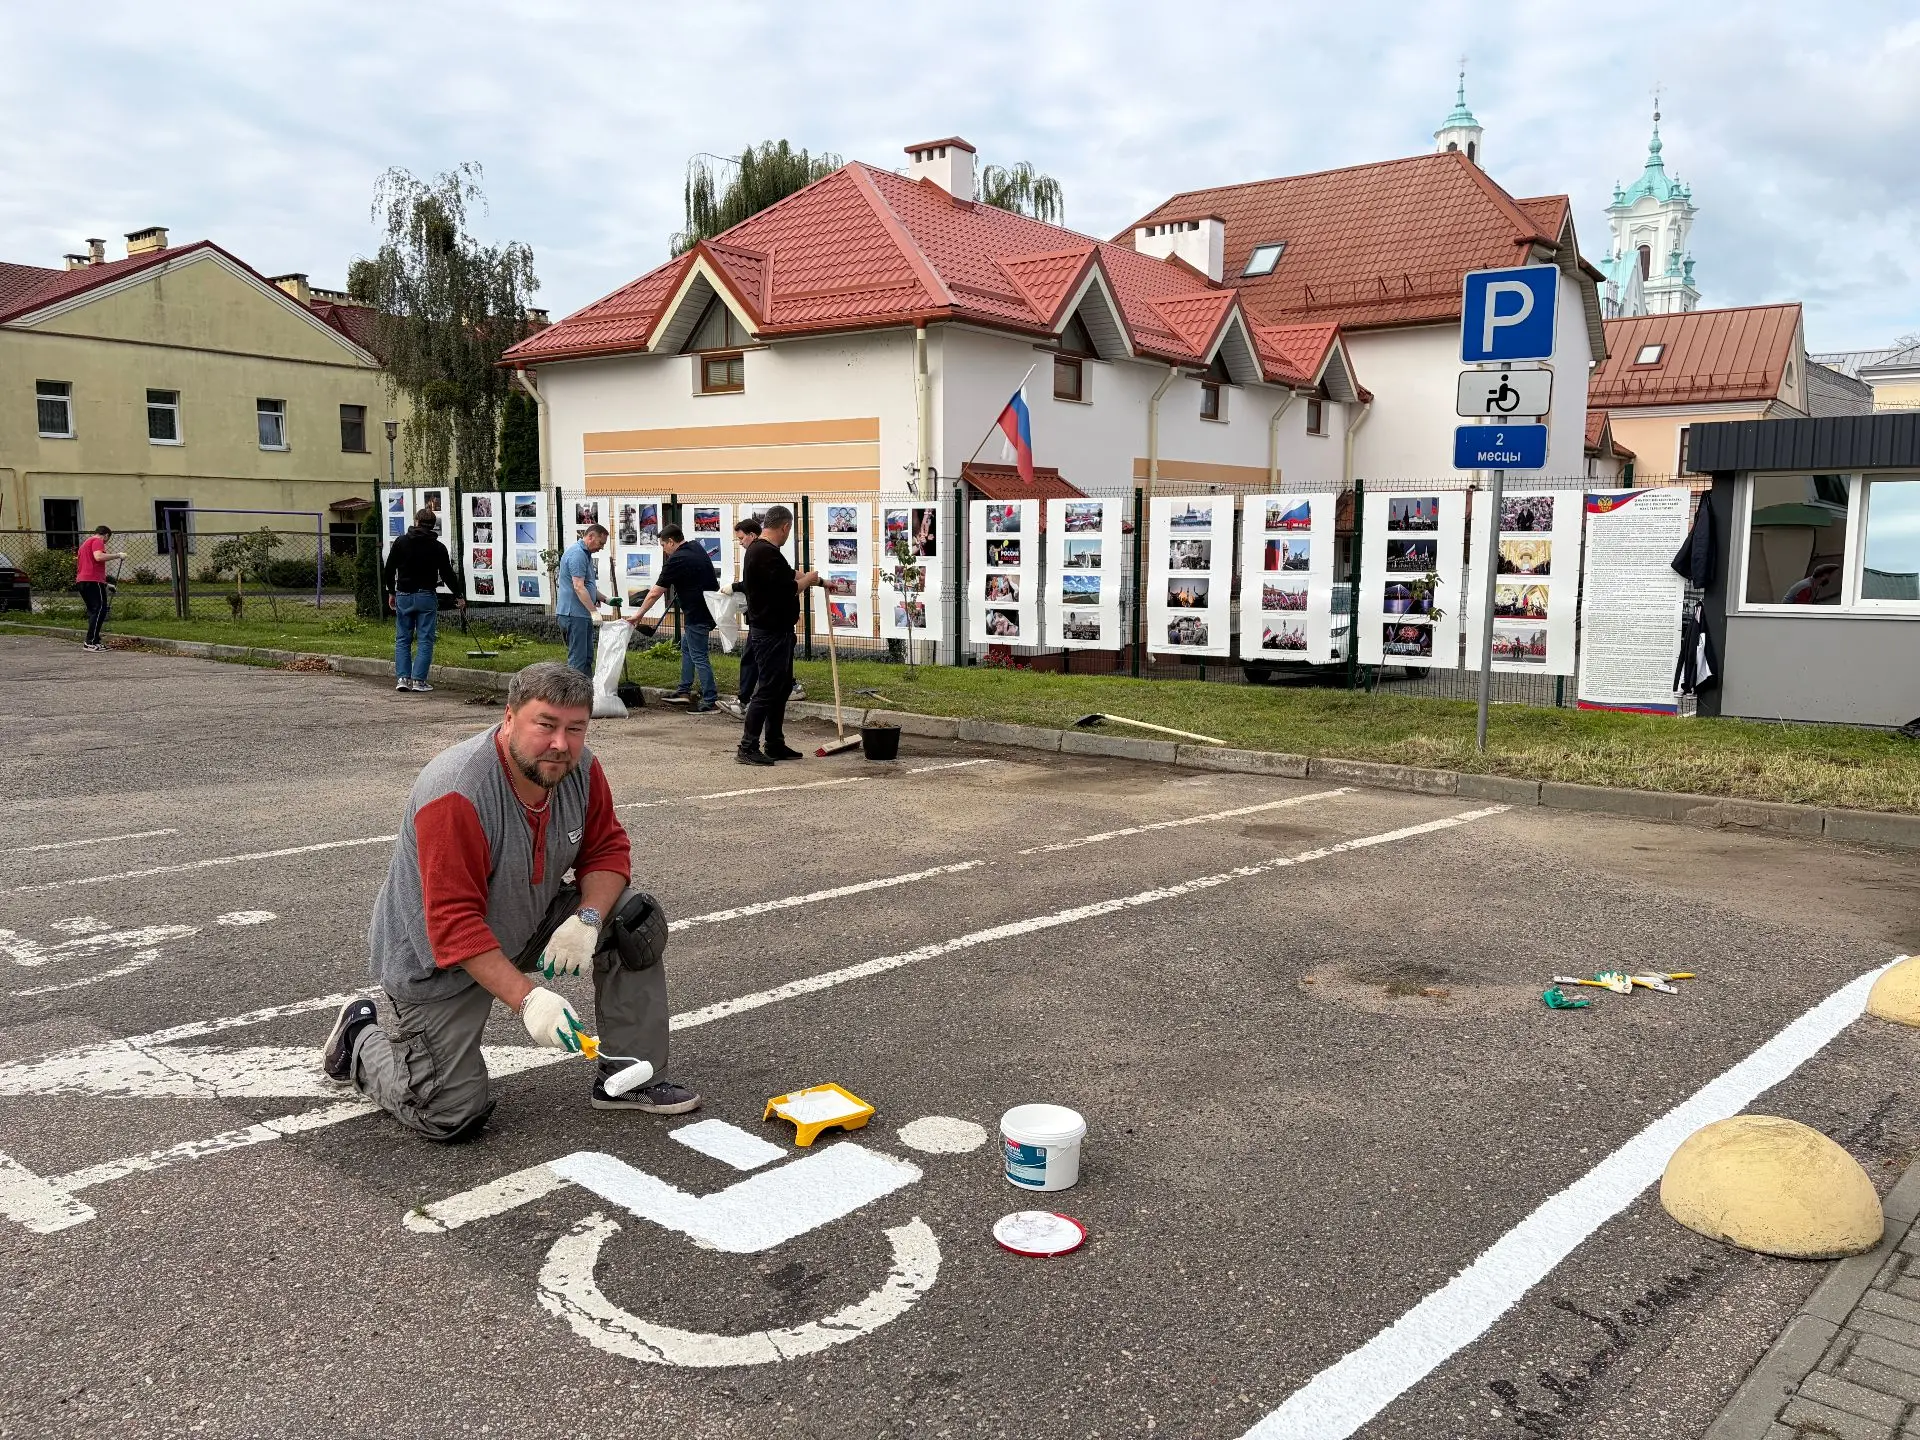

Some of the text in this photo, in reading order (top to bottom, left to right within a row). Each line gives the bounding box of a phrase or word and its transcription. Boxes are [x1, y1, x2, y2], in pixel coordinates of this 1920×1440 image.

[1482, 281, 1534, 352] P
[1496, 433, 1503, 446] 2
[1477, 450, 1520, 463] месцы
